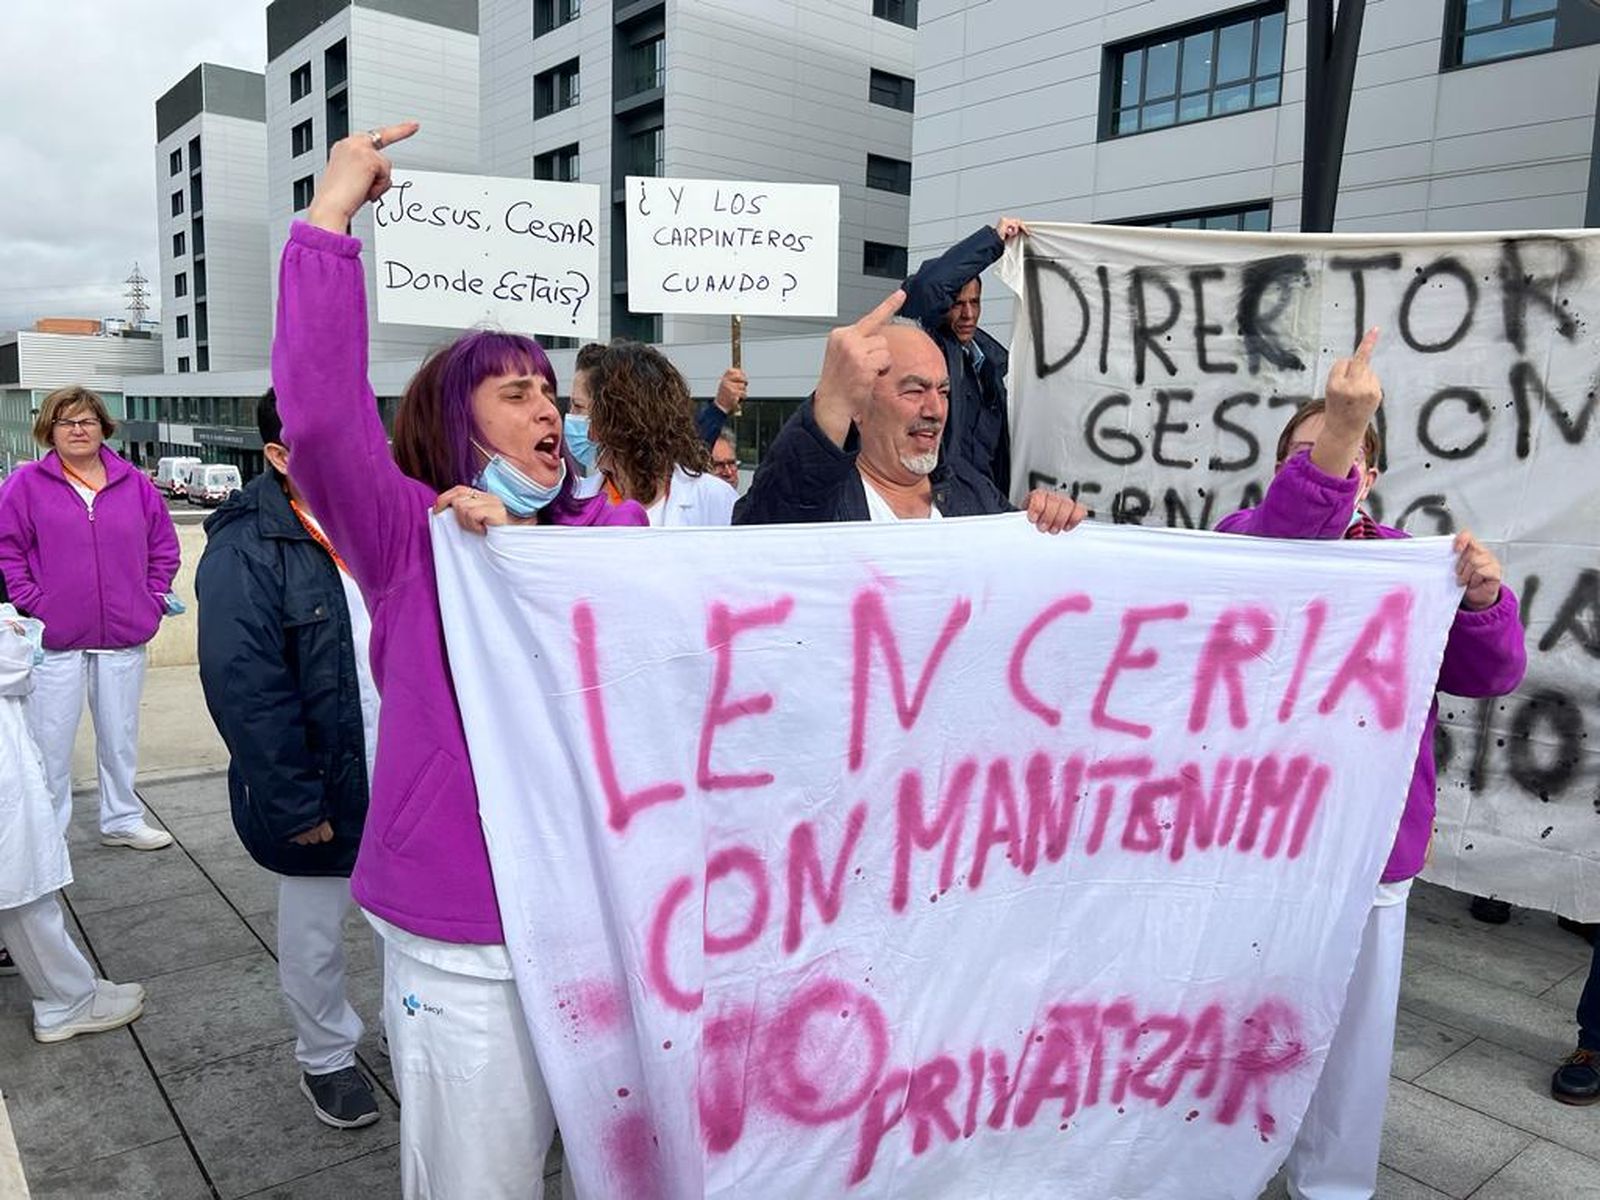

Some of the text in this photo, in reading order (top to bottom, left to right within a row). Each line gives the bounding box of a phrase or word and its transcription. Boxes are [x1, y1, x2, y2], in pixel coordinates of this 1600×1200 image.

[714, 189, 768, 215] LOS
[653, 226, 813, 252] CARPINTEROS
[384, 260, 484, 295] Donde
[571, 584, 1416, 833] LENCERIA
[645, 803, 866, 1012] CON
